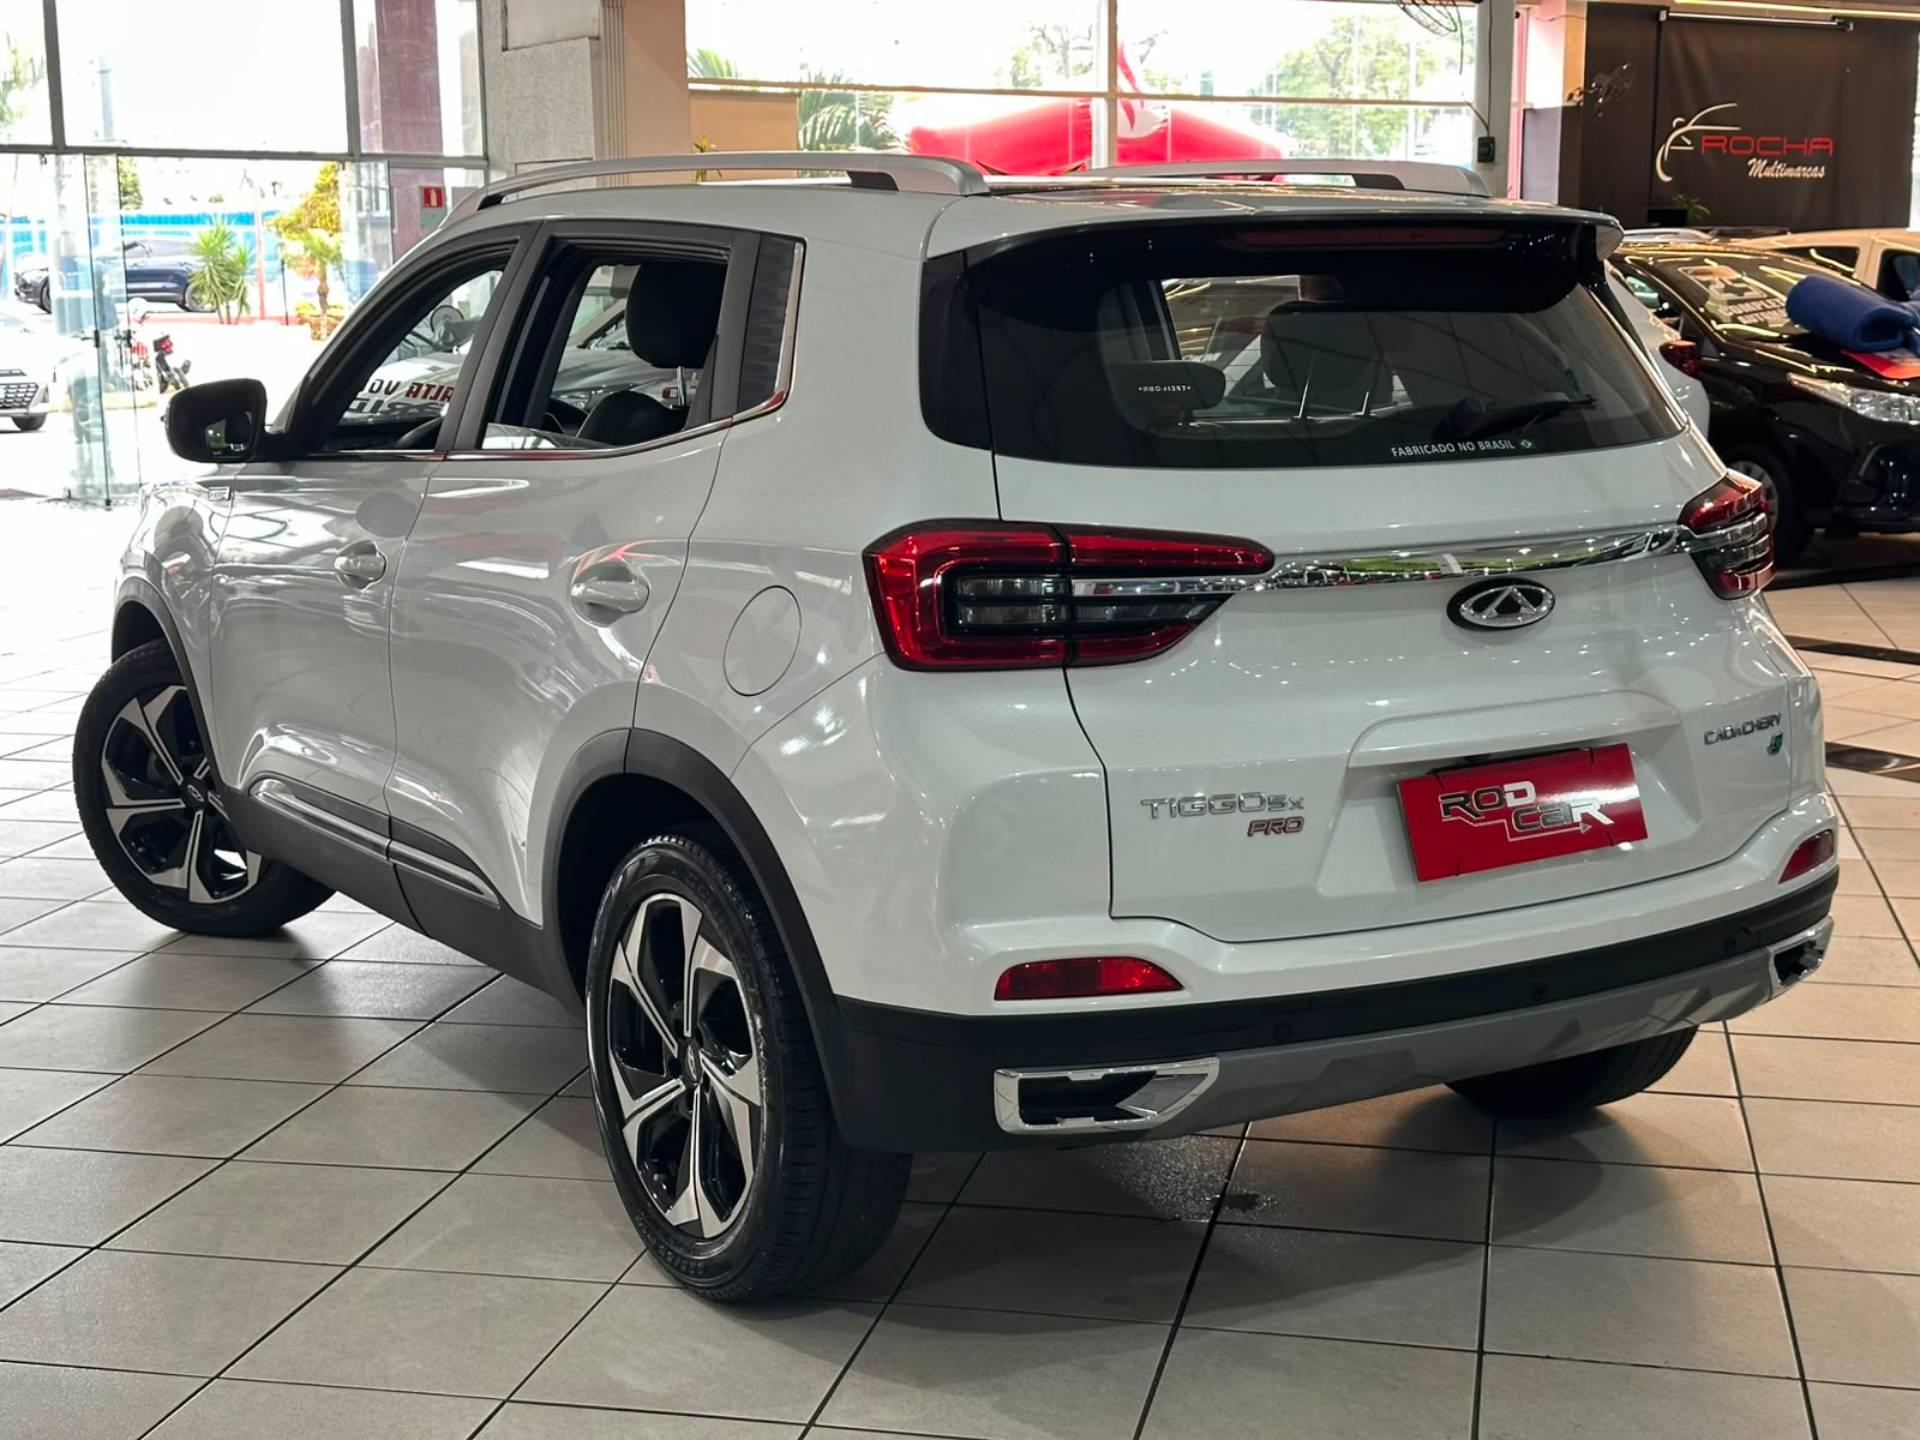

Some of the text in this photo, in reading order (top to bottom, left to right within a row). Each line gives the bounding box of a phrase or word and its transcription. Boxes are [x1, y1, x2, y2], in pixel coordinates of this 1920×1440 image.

[1701, 135, 1835, 157] ROCHA
[1747, 158, 1826, 179] Multimarcas
[1391, 439, 1515, 457] FABRICADO NO BRASIL
[1438, 780, 1537, 819] ROD
[1247, 816, 1305, 837] PRO
